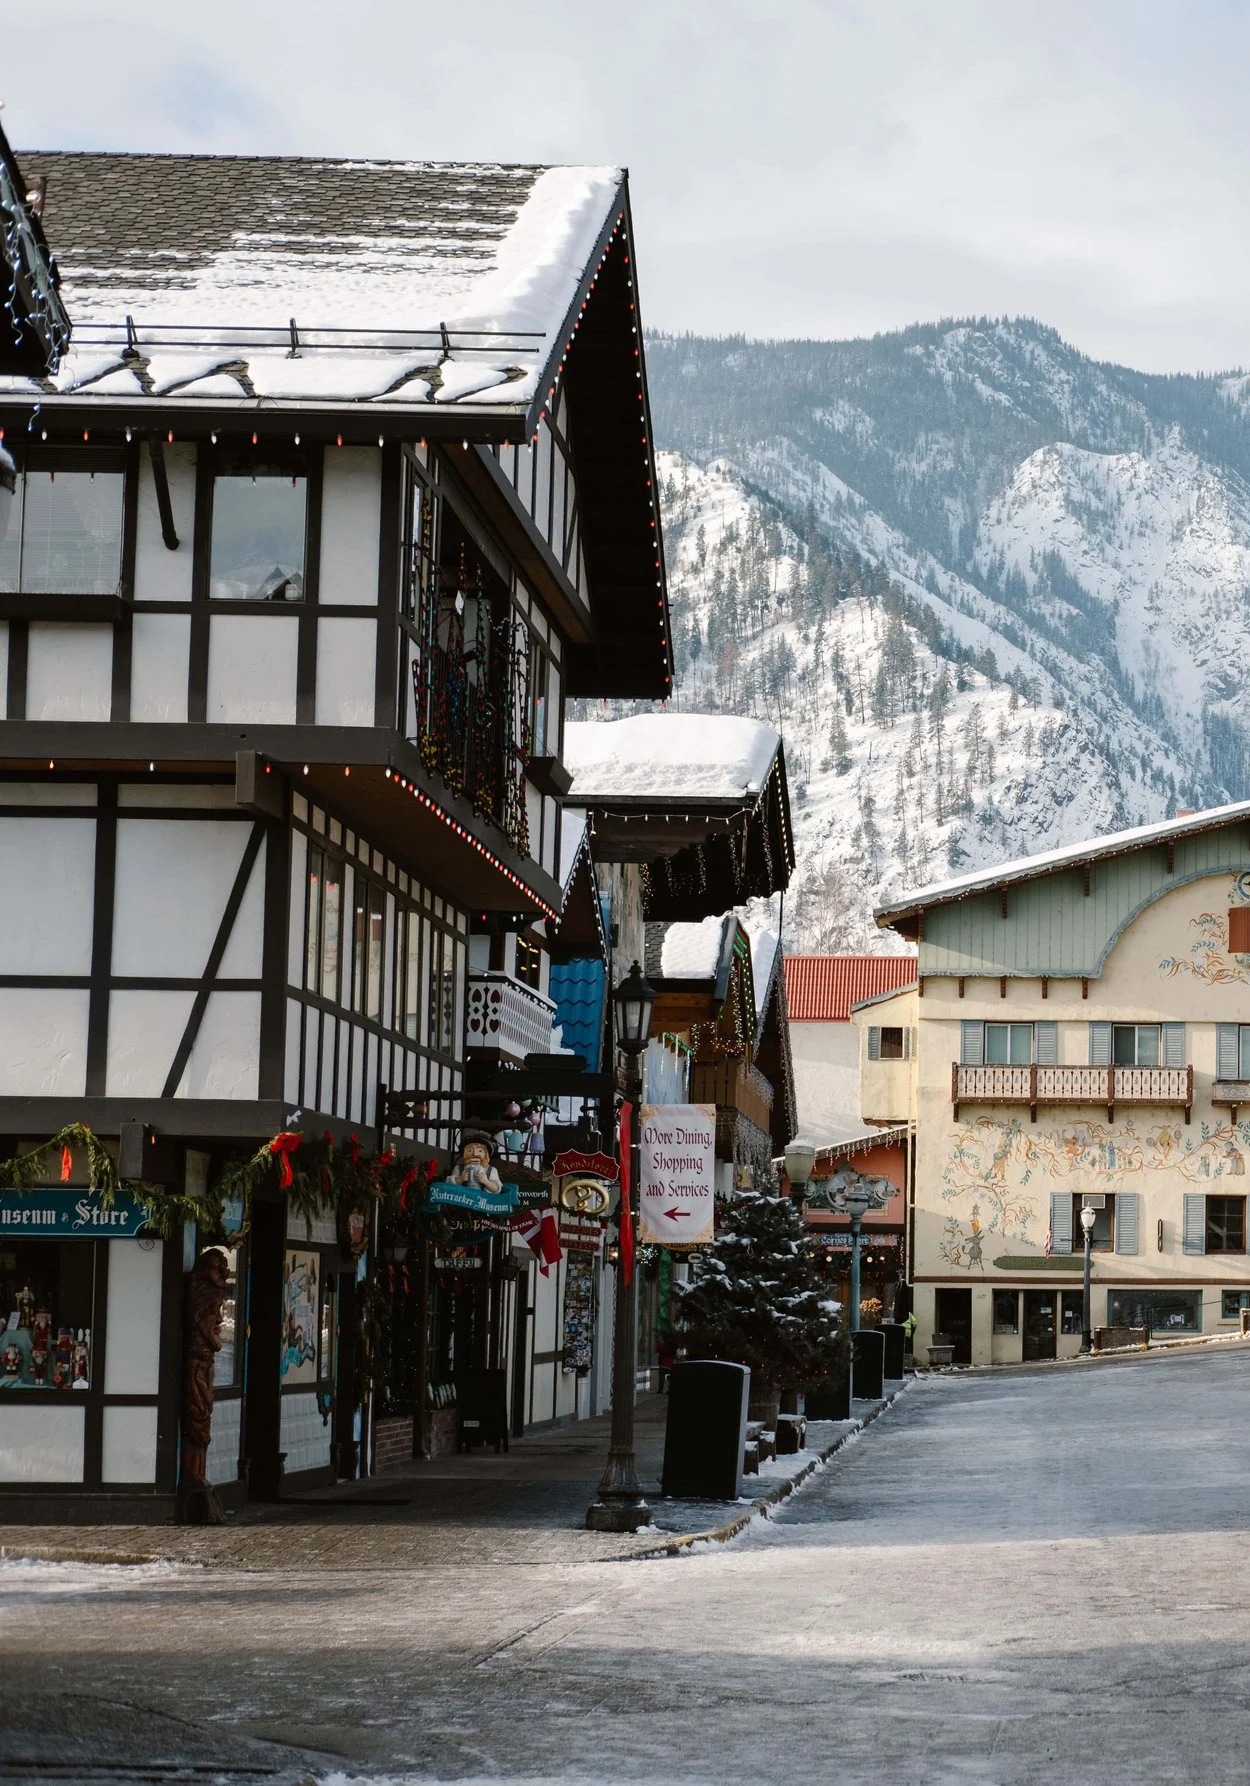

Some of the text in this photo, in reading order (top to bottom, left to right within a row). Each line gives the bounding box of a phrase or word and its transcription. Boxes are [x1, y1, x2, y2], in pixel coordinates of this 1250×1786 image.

[645, 1128, 672, 1144] More
[653, 1152, 703, 1174] Shopping
[430, 1187, 509, 1212] Nutcracker Museum
[646, 1180, 709, 1197] and Services
[0, 1199, 56, 1225] useum
[72, 1199, 129, 1229] Store
